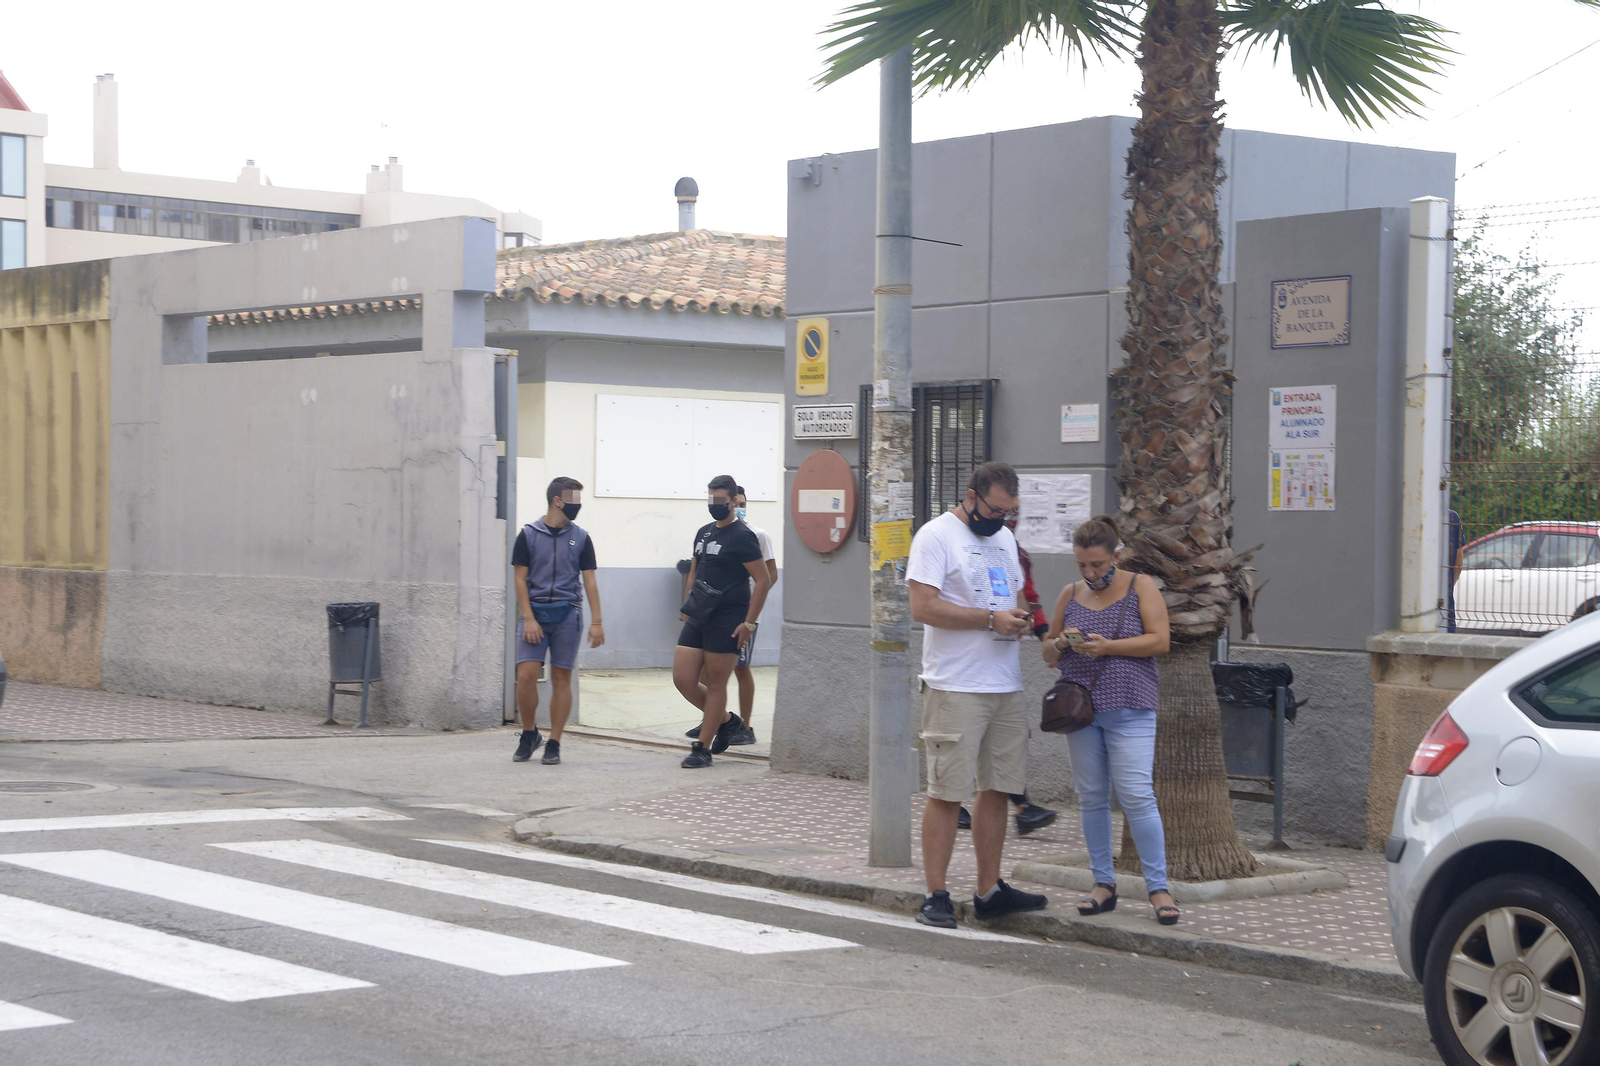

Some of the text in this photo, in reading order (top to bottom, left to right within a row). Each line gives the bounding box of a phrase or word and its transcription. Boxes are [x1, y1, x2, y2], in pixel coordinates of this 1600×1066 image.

[1290, 294, 1332, 306] AVENIDA
[1297, 308, 1324, 319] DE LA
[1286, 321, 1335, 333] BANQUETA
[1283, 392, 1322, 403] ENTRADA
[797, 410, 853, 421] SOLO VEHICULOS
[1281, 405, 1324, 416] PRINCIPAL
[1280, 417, 1325, 428] ALUMNADO
[1285, 429, 1320, 439] ALA SUR
